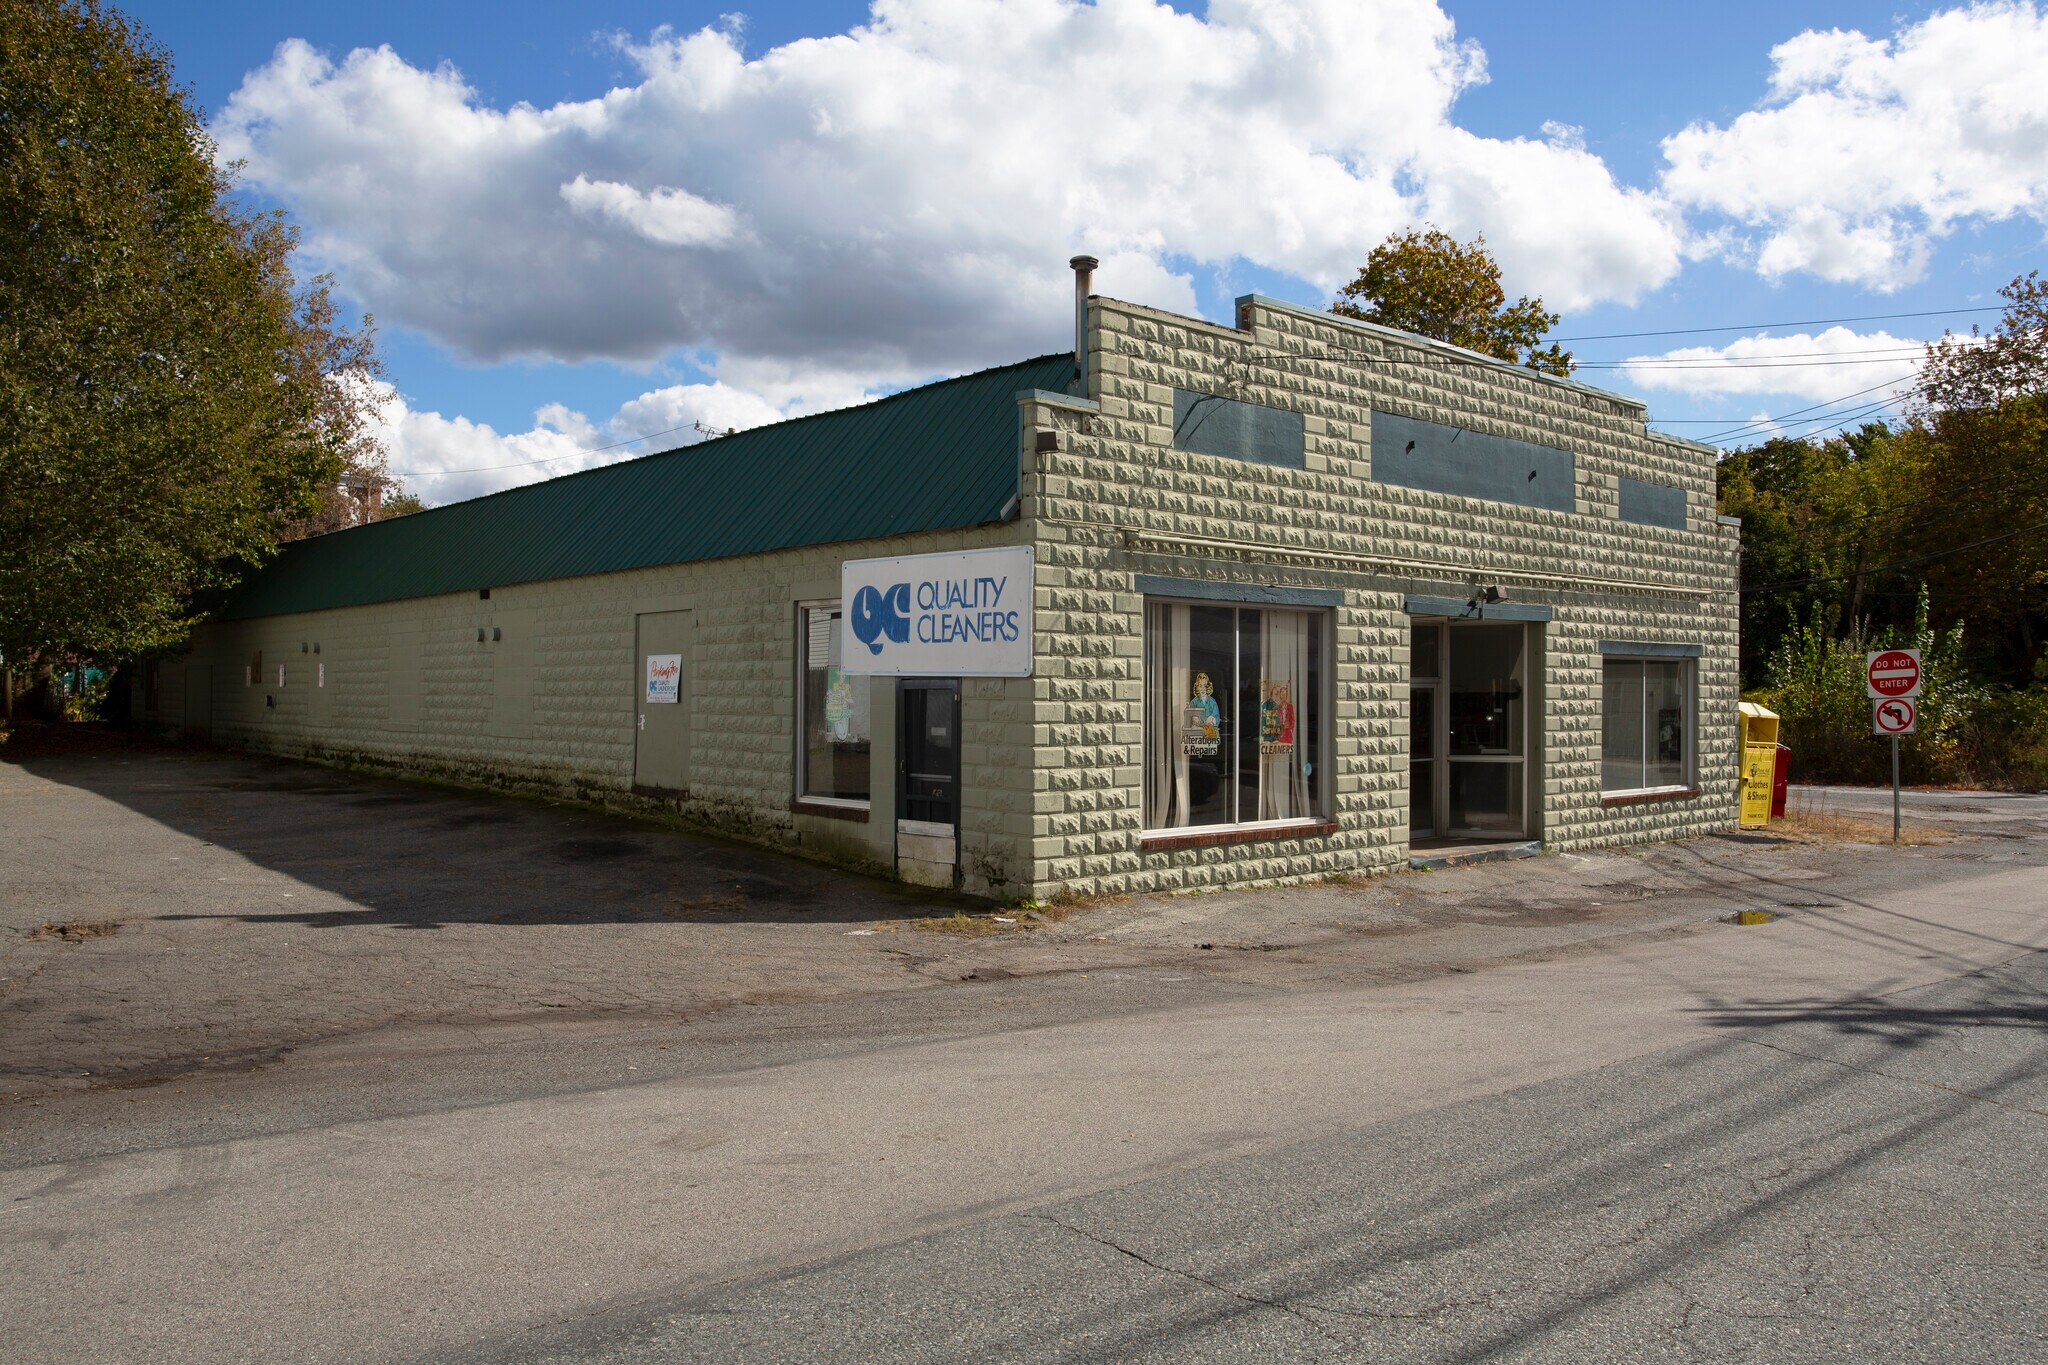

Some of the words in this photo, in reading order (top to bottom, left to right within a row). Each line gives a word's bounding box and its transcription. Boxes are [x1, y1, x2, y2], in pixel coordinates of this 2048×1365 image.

[917, 576, 1008, 611] QUALITY
[851, 583, 911, 656] QC
[917, 610, 1020, 643] CLEANERS
[1893, 658, 1911, 667] NOT
[1879, 679, 1908, 688] ENTER
[1263, 708, 1278, 717] Same
[1266, 717, 1276, 727] Day
[1262, 726, 1281, 735] Service
[1180, 735, 1221, 746] Alterations
[1183, 746, 1190, 755] &
[1190, 746, 1218, 758] Repairs
[1260, 745, 1294, 755] CLEANERS
[1747, 791, 1752, 801] &
[1752, 791, 1768, 801] Shoes
